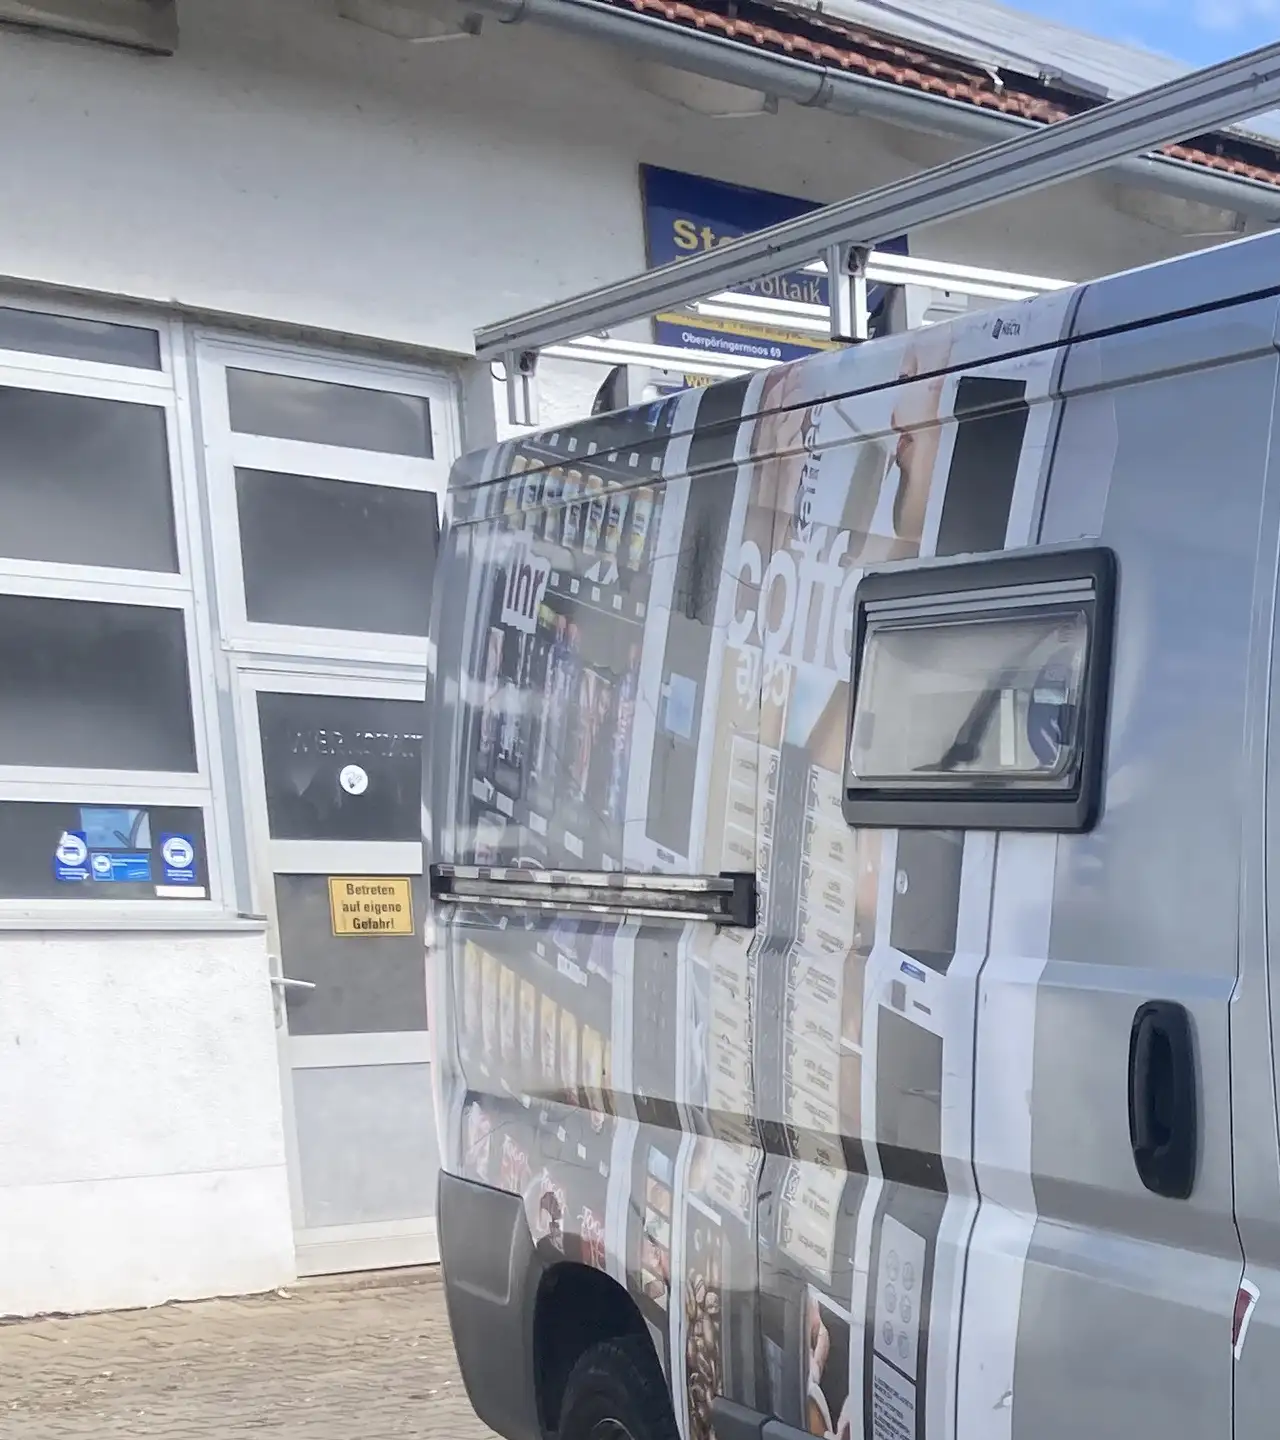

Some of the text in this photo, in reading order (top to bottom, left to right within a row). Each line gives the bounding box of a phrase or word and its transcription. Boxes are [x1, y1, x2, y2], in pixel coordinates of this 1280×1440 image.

[346, 883, 395, 896] Betreten
[342, 900, 402, 915] auf eigene
[352, 917, 395, 930] Gefahr!
